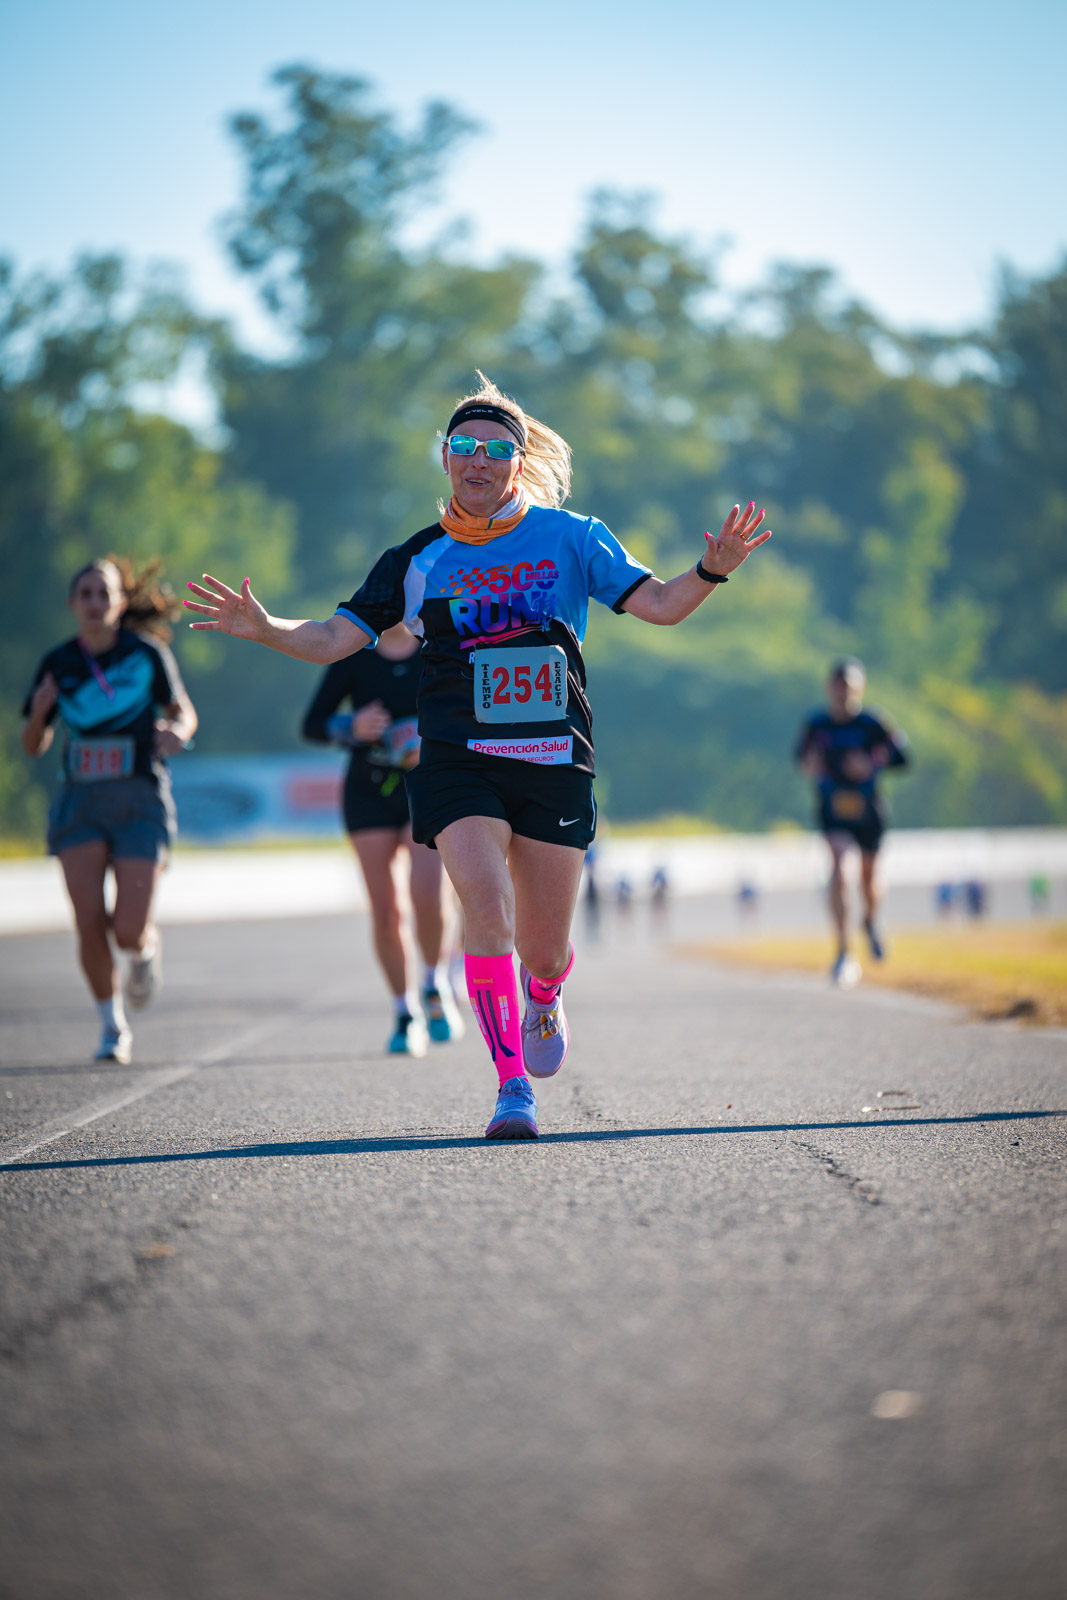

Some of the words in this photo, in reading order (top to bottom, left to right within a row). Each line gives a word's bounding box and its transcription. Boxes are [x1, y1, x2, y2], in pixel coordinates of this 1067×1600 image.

[487, 560, 557, 594] 500
[525, 570, 560, 581] MILLAS
[481, 664, 491, 709] TIEMPO
[492, 664, 553, 705] 254
[554, 661, 562, 707] EXACTO
[473, 743, 539, 754] Prevención
[541, 739, 569, 752] Salud
